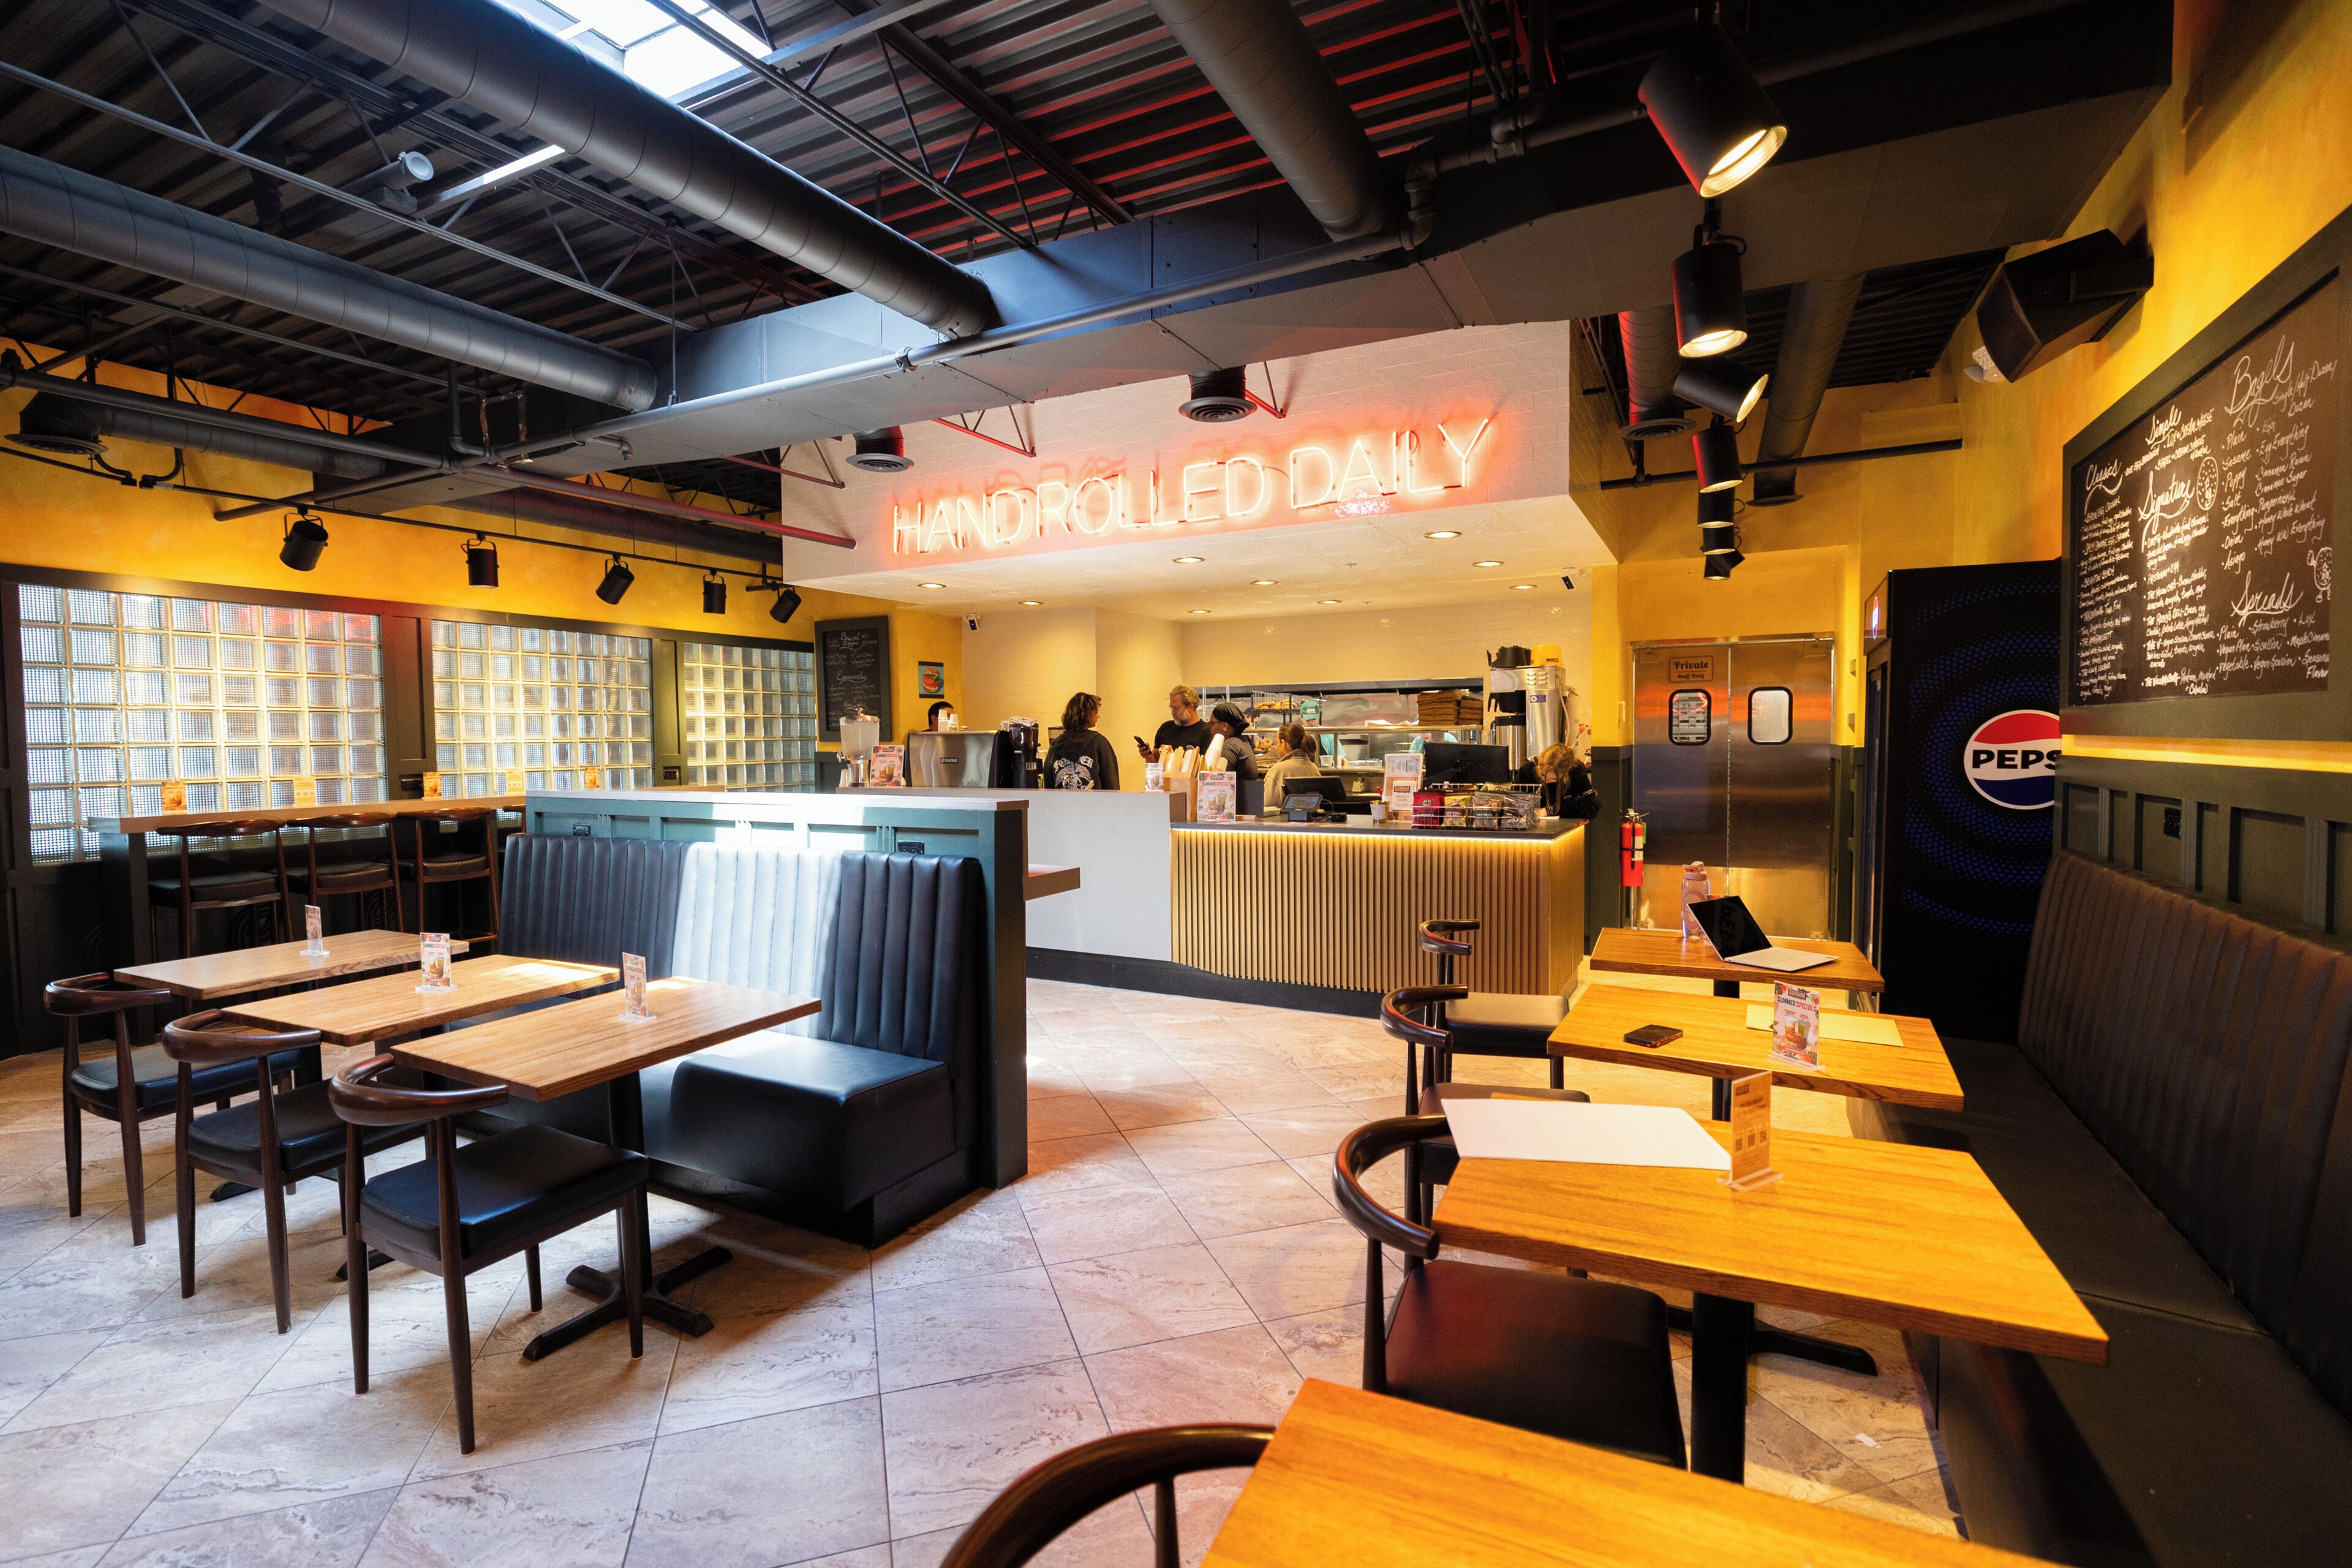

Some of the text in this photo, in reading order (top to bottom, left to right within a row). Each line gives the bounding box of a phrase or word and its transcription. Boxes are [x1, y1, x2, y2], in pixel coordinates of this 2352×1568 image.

[2225, 334, 2294, 427] Bagels
[2146, 405, 2182, 445] Simple
[2272, 423, 2310, 461] Everything
[1290, 418, 1489, 510] DAILY
[2223, 449, 2252, 470] Sesame
[2225, 467, 2247, 492] Poppy
[2138, 470, 2195, 535] Signature
[2223, 504, 2255, 535] Everything
[2290, 513, 2326, 545] Everything
[2231, 570, 2304, 626] Spreads
[2219, 625, 2239, 641] Plain
[2251, 617, 2290, 638] Strawberry
[1673, 660, 1709, 669] Private
[2301, 649, 2329, 667] Seasona
[1972, 749, 2062, 770] PEPS
[1777, 997, 1817, 1012] SUMMER SPECIALS
